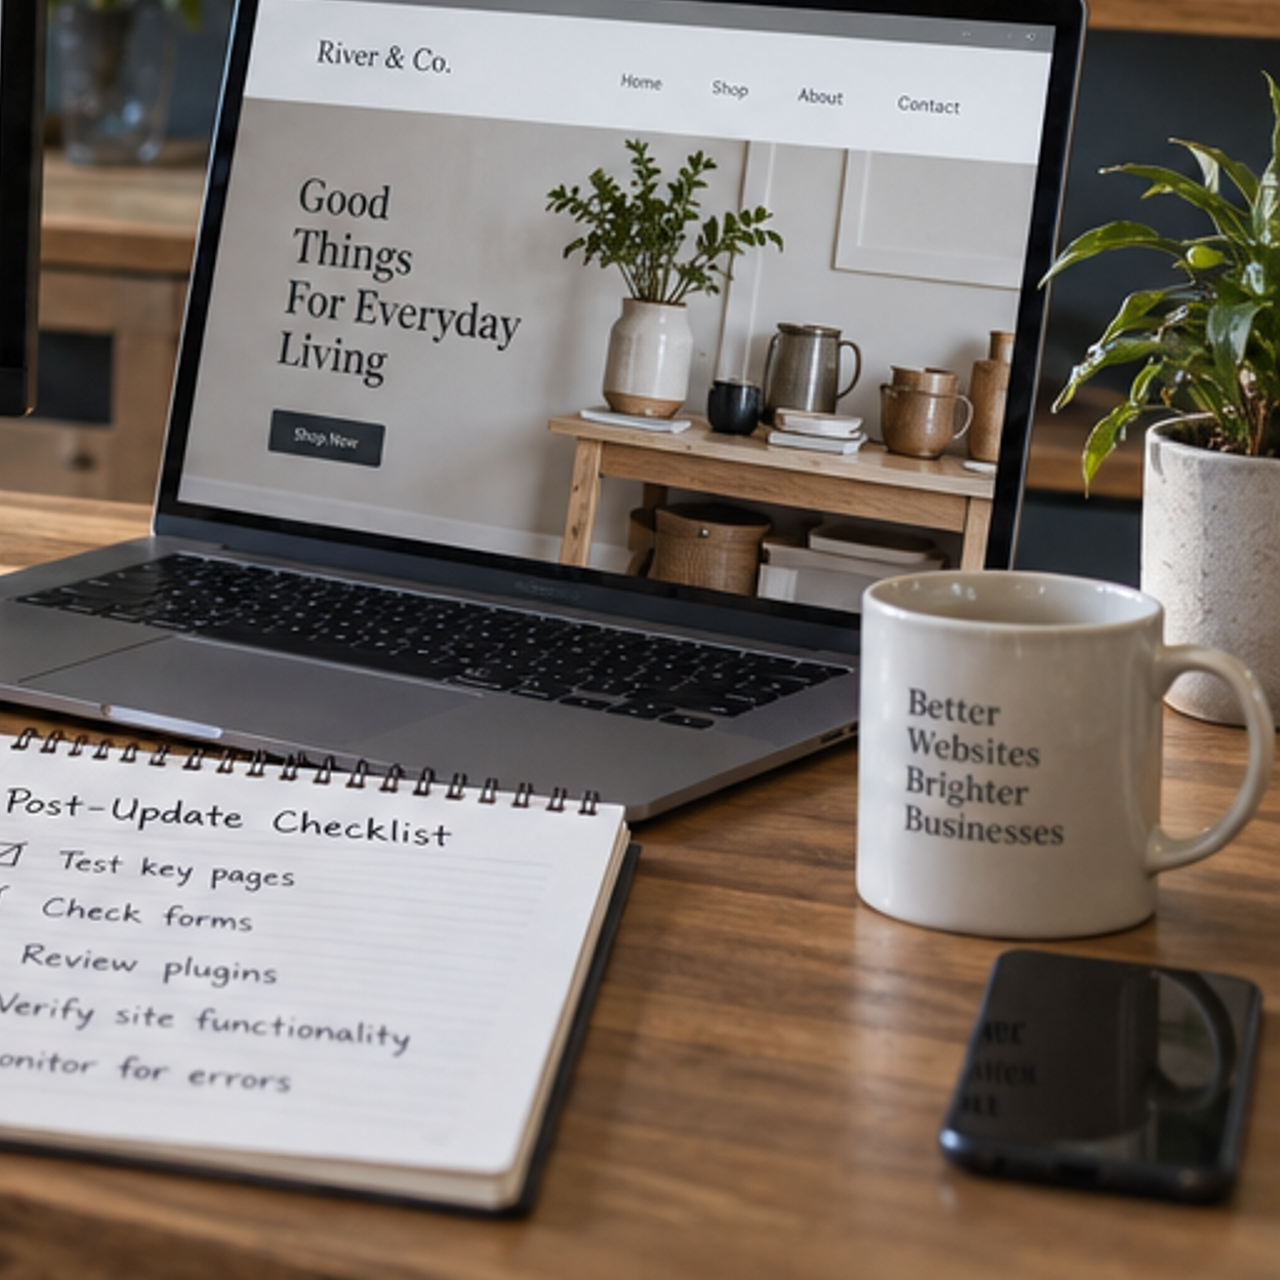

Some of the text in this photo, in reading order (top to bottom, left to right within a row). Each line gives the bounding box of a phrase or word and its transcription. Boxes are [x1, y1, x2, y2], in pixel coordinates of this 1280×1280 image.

[317, 39, 451, 74] River & Co.
[620, 73, 960, 115] Home Shop About Contact
[299, 178, 390, 220] Good
[293, 227, 412, 284] Things
[285, 279, 522, 352] For Everyday
[278, 330, 388, 389] Living
[908, 688, 1001, 726] Better
[907, 727, 1041, 768] Websites
[905, 766, 1030, 808] Brighter
[6, 787, 452, 847] Post-Update Checklist
[904, 806, 1065, 847] Businesses
[59, 850, 295, 892] Test key pages
[42, 897, 253, 932] Check forms
[21, 943, 277, 988] Review plugins
[115, 1006, 174, 1028] site
[195, 1007, 411, 1058] functionality
[118, 1055, 168, 1081] for
[187, 1069, 291, 1093] errors
